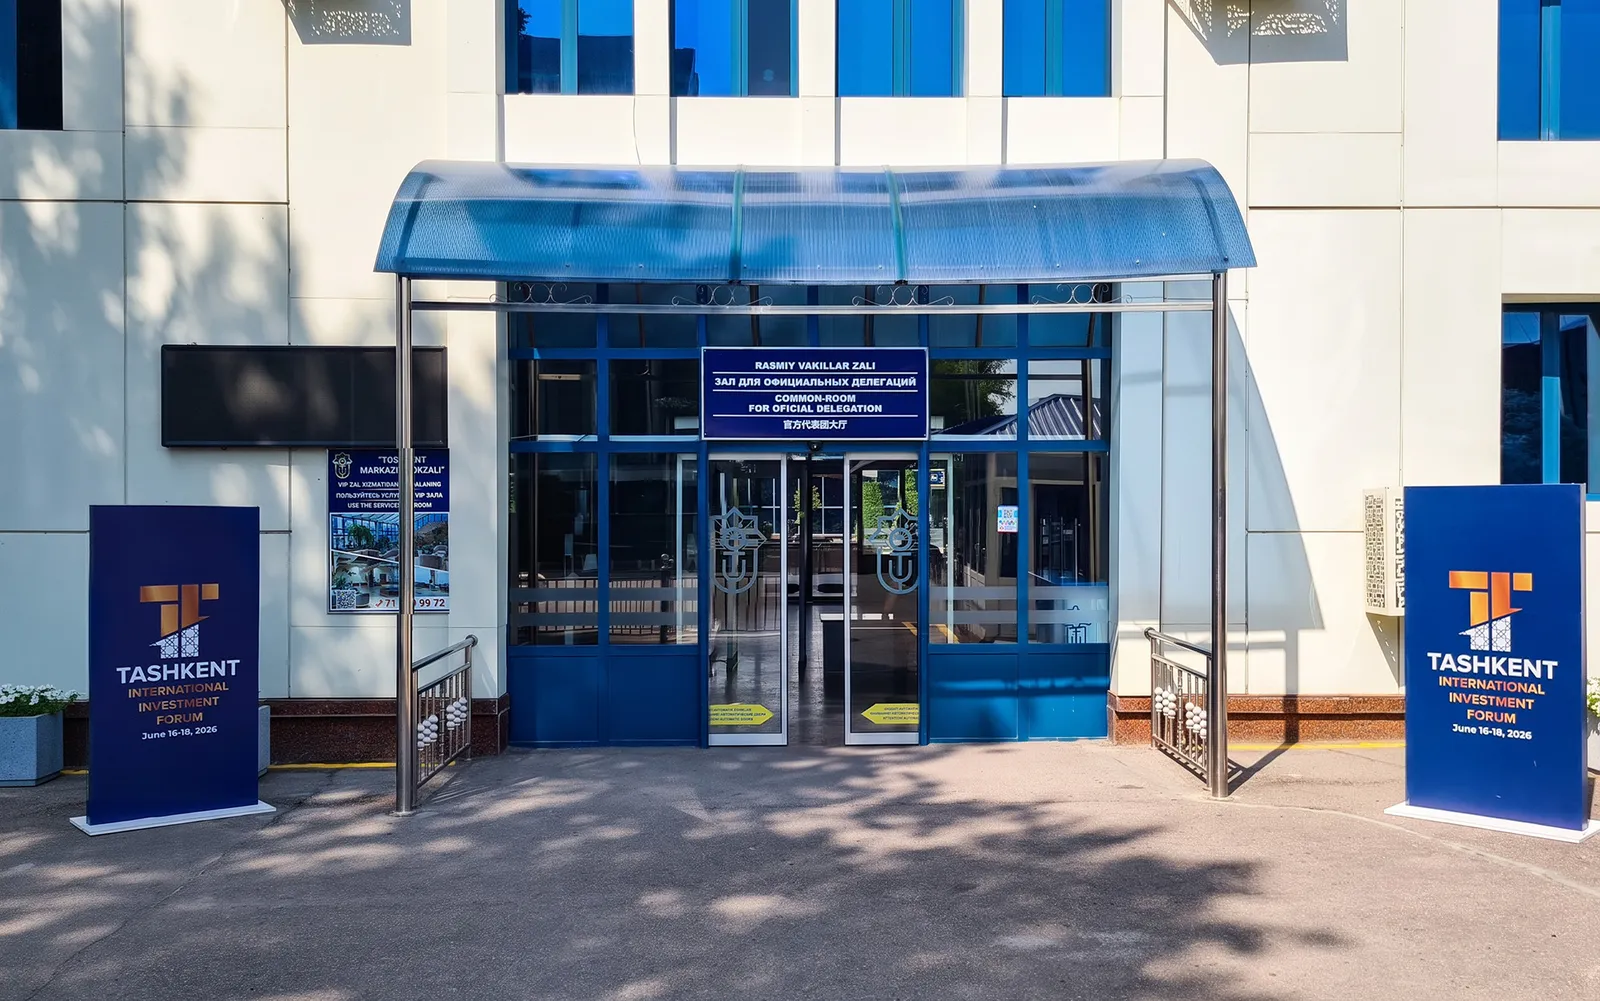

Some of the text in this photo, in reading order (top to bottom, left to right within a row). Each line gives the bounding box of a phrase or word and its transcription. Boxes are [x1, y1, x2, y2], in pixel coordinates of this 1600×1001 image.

[755, 362, 876, 370] RASMIY VAKILLAR ZALI
[714, 376, 916, 387] ЗАЛ ДЛЯ ОФИЦИАЛЬНЫХ ДЕЛЕГАЦИЙ
[775, 394, 856, 403] COMMON-ROOM
[748, 404, 882, 413] FOR OFICIAL DELEGATION
[783, 420, 848, 430] 官方代表团大厅
[385, 599, 396, 607] 71
[419, 599, 431, 607] 99
[433, 599, 445, 607] 72
[116, 660, 240, 684] TASHKENT
[1427, 652, 1558, 680] TASHKENT
[128, 682, 229, 698] INTERNATIONAL
[1439, 676, 1545, 695] INTERNATIONAL
[138, 696, 220, 712] INVESTMENT
[1449, 692, 1534, 710] INVESTMENT
[156, 712, 203, 725] FORUM
[1467, 709, 1516, 724] FORUM
[142, 726, 218, 740] June 16-18, 2026
[1452, 724, 1532, 740] June 16-18, 2026
